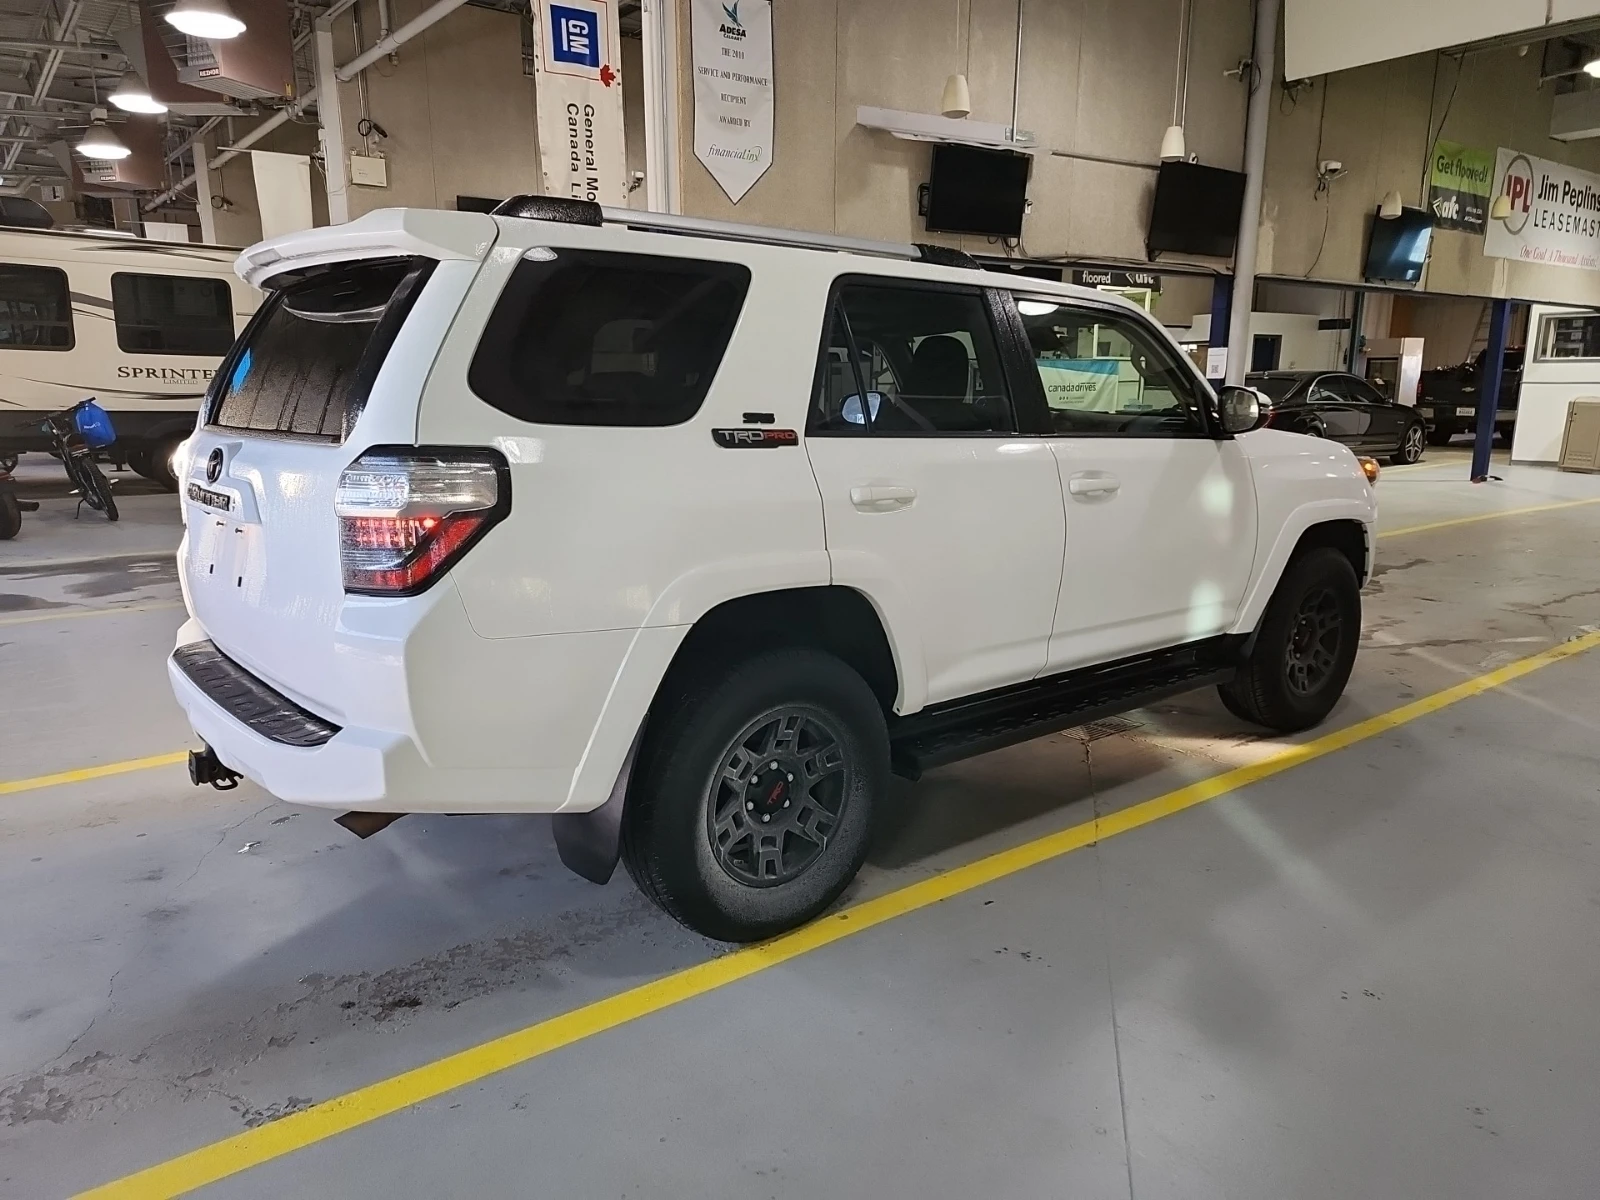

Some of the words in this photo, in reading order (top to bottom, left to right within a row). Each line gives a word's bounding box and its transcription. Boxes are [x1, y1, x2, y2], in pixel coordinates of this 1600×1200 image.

[568, 20, 590, 54] GM
[719, 24, 746, 37] ADESA
[698, 66, 719, 78] SERVICE
[720, 70, 731, 80] AND
[732, 73, 768, 86] PERFORMANCE
[567, 103, 581, 172] Canada
[583, 104, 598, 171] General
[1437, 155, 1454, 175] Get
[1455, 159, 1488, 183] floored!
[1538, 174, 1559, 202] Jim
[1442, 195, 1459, 220] afc
[1082, 270, 1111, 284] floored
[117, 366, 220, 381] SPRINTE
[718, 430, 765, 444] TRD
[764, 431, 796, 440] PRO
